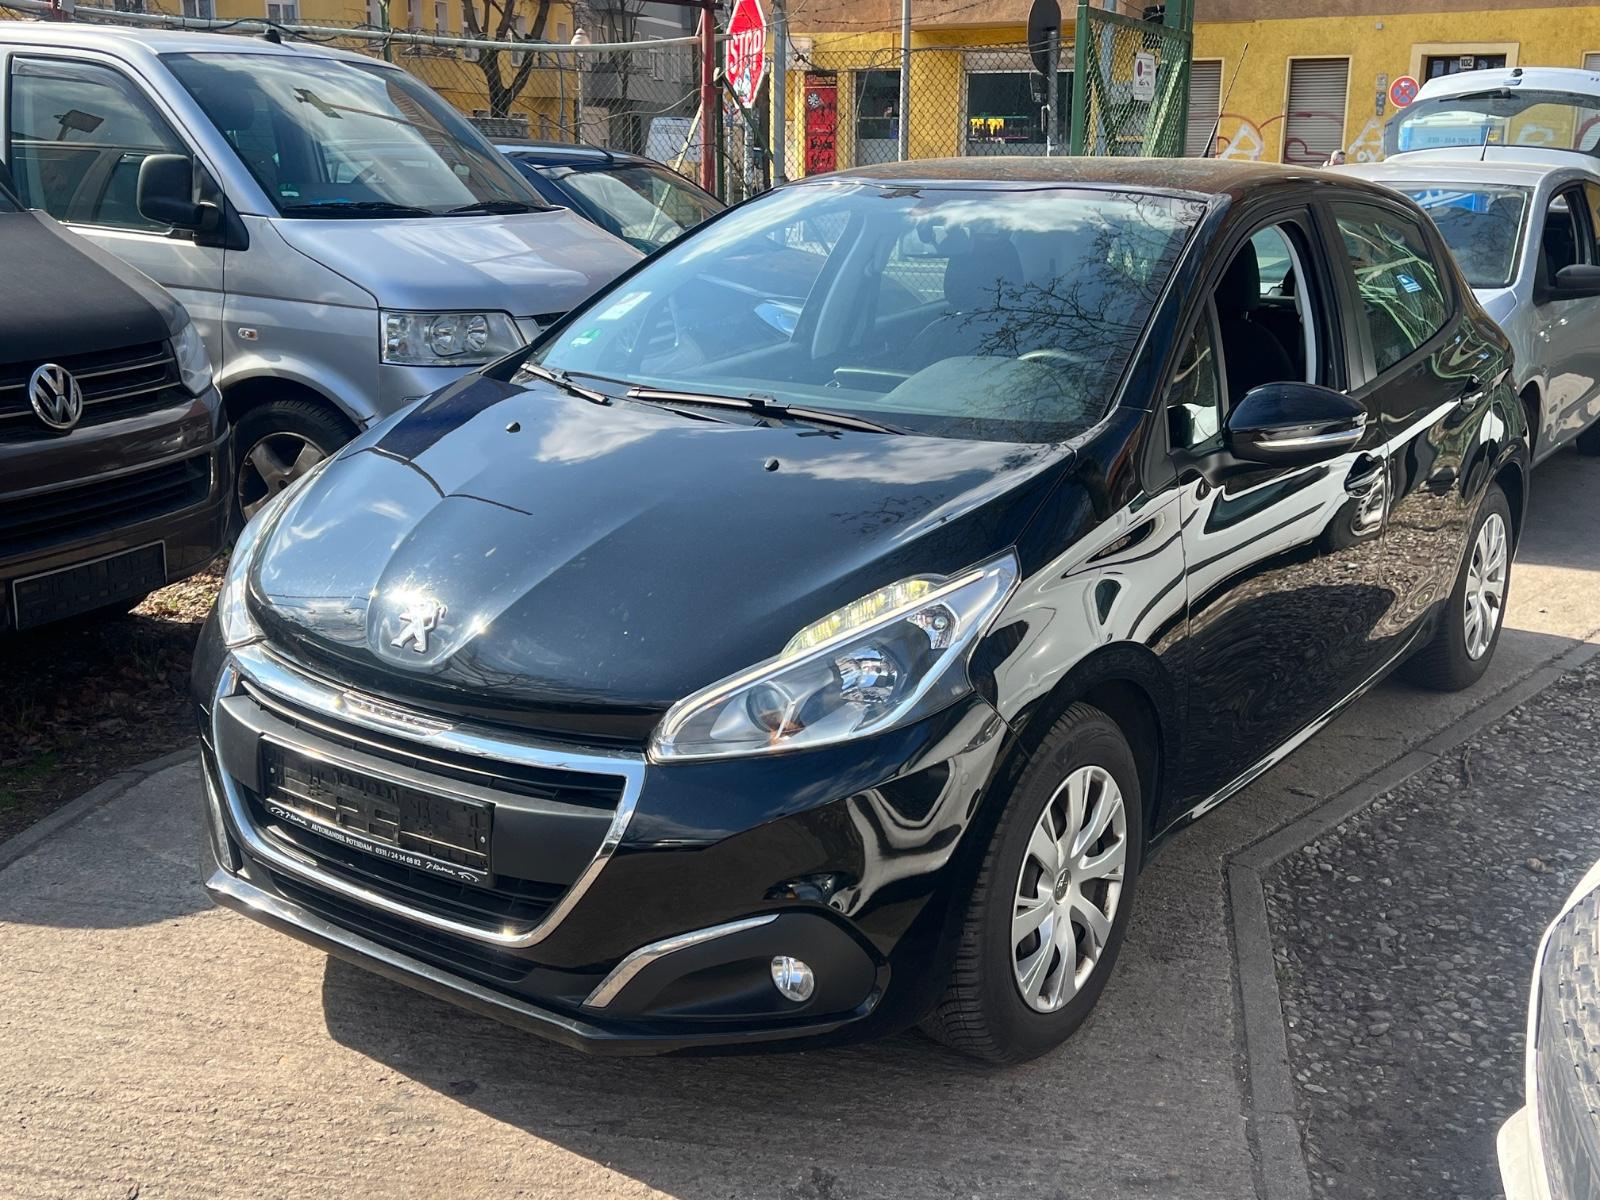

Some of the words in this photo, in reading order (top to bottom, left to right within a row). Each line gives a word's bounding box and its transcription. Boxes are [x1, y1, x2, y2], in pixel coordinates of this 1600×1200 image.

[730, 28, 762, 74] STOP
[1460, 58, 1473, 67] 102
[346, 838, 373, 852] POTSDAM
